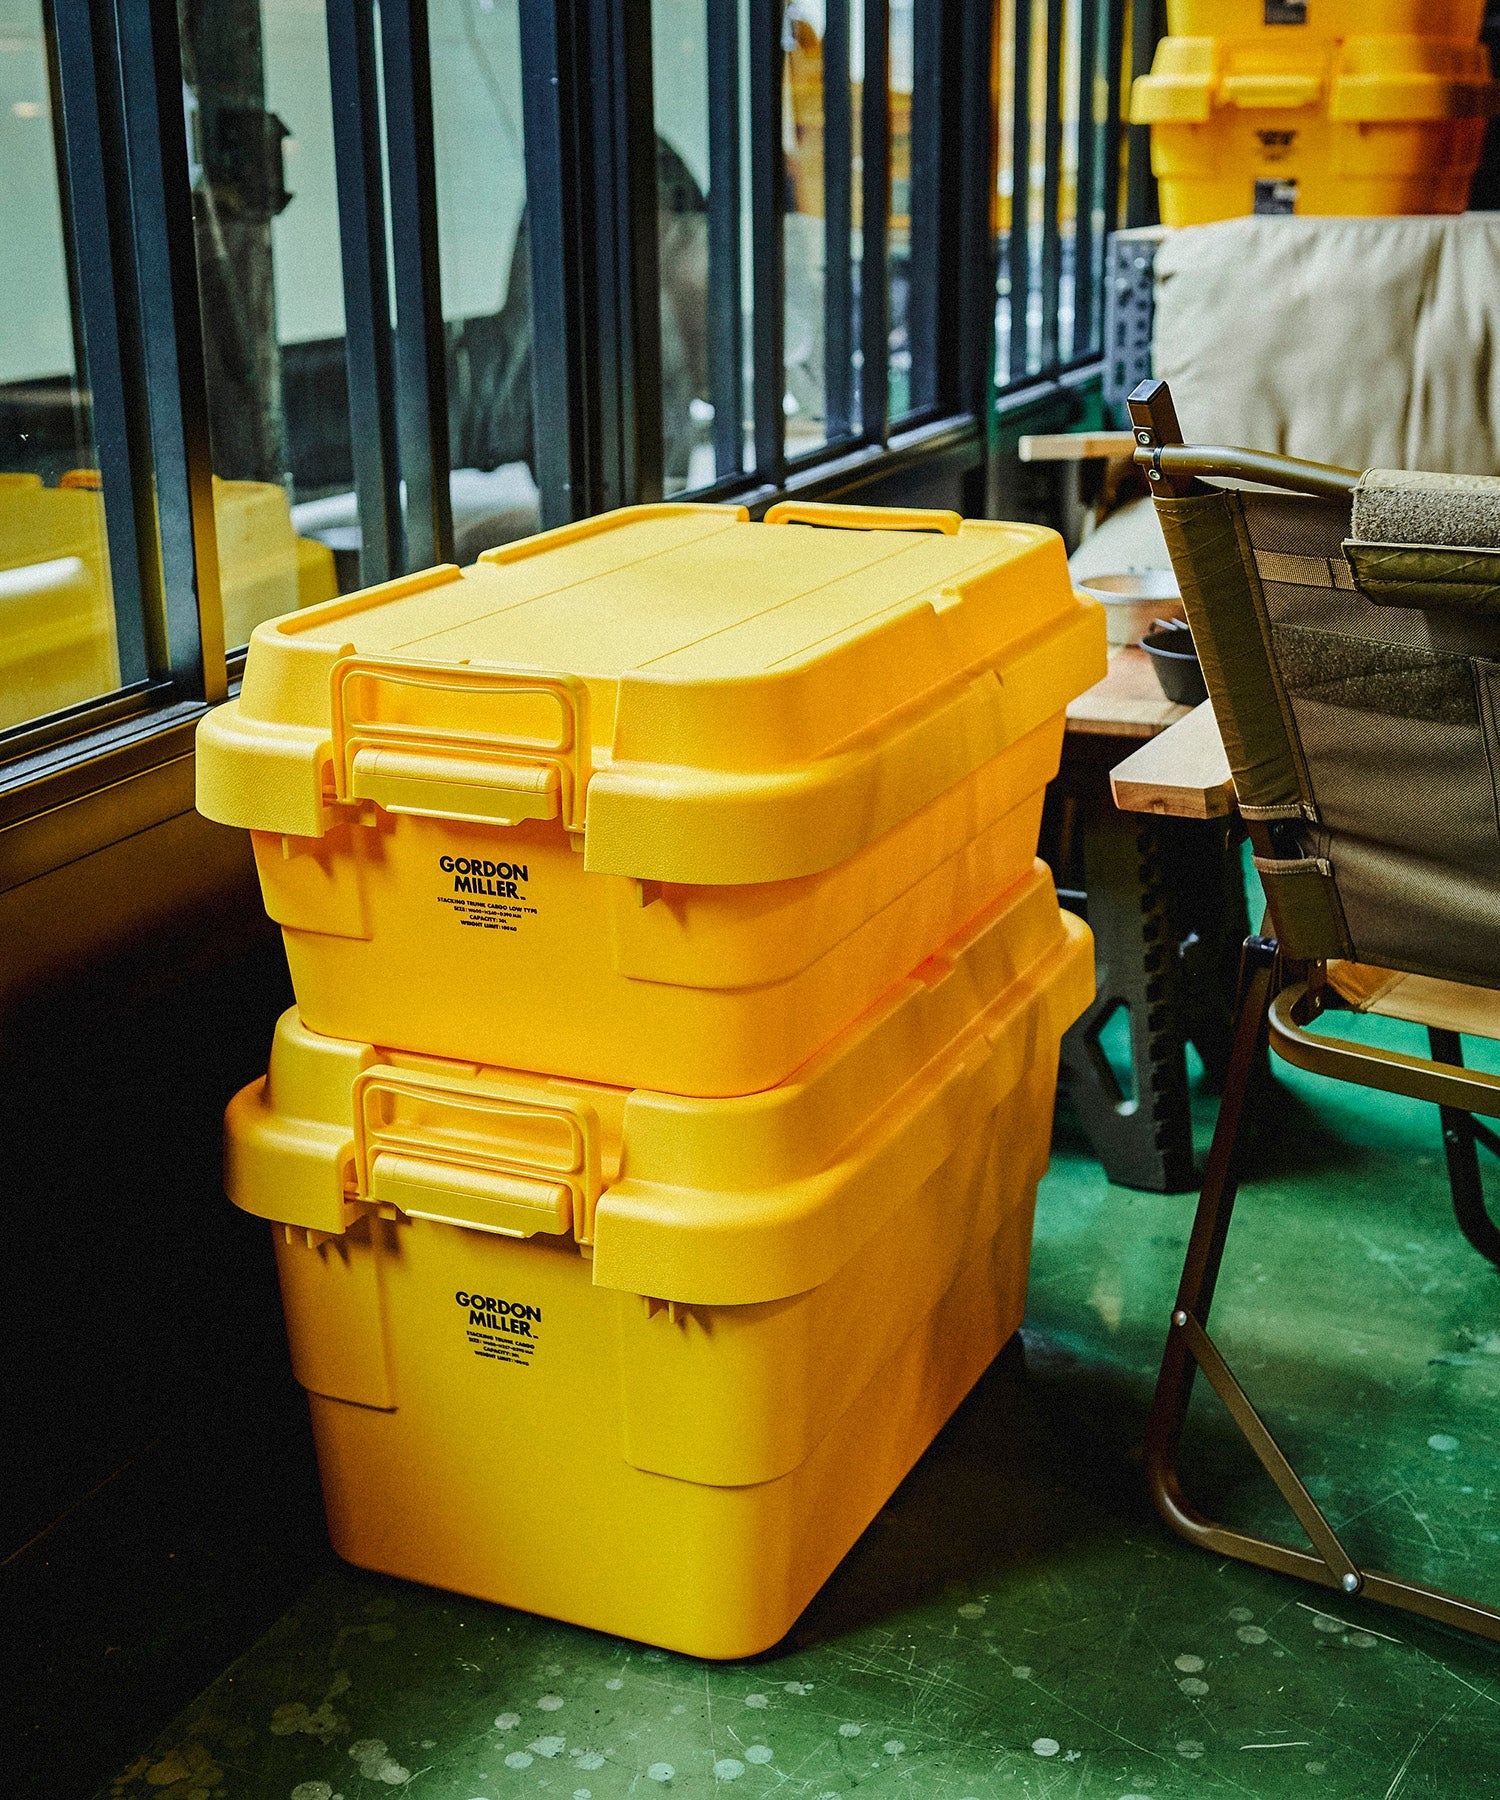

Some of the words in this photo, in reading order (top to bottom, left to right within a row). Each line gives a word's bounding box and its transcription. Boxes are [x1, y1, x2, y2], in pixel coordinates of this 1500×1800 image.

[440, 856, 528, 882] GORDON
[454, 875, 519, 899] MILLER
[456, 1291, 541, 1323] GORDON
[469, 1310, 532, 1338] MILLER
